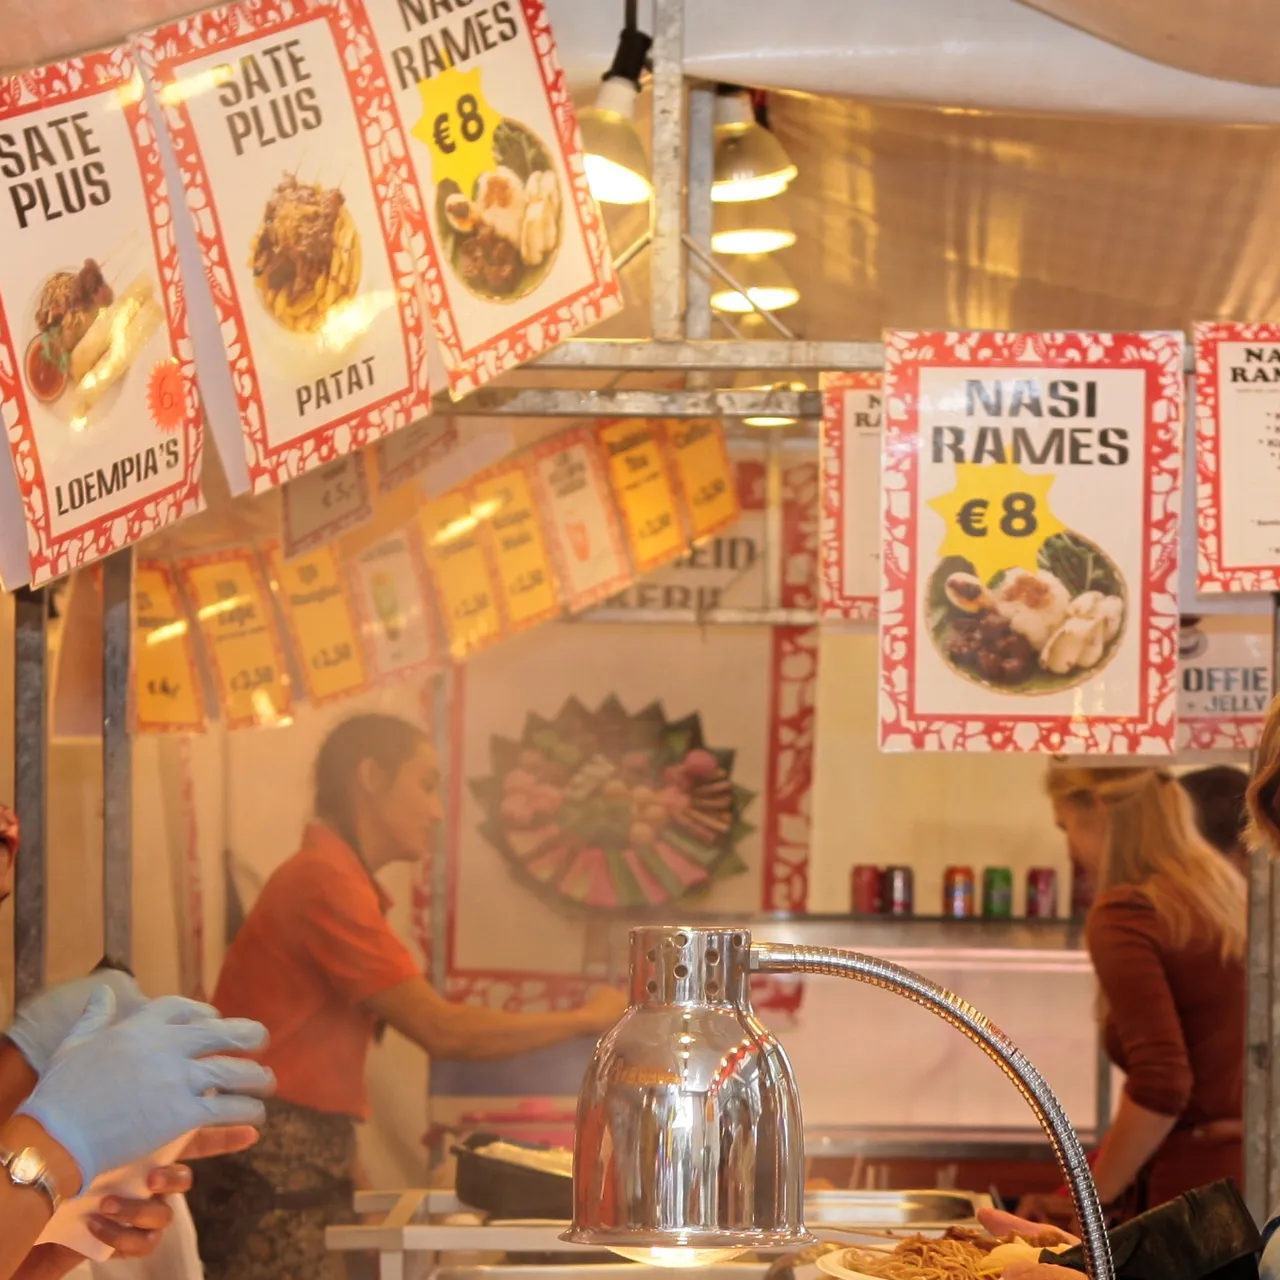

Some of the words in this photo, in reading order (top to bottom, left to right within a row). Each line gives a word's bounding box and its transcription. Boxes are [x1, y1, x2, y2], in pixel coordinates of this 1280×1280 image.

[212, 38, 312, 108] SATE
[391, 0, 518, 91] RAMES
[225, 86, 323, 157] PLUS
[8, 160, 112, 230] PLUS
[295, 355, 376, 418] PATAT
[966, 378, 1098, 418] NASI
[55, 437, 180, 517] LOEMPIA'S
[931, 425, 1131, 466] RAMES
[1182, 667, 1268, 692] OFFIE
[1204, 695, 1267, 712] JELLY
